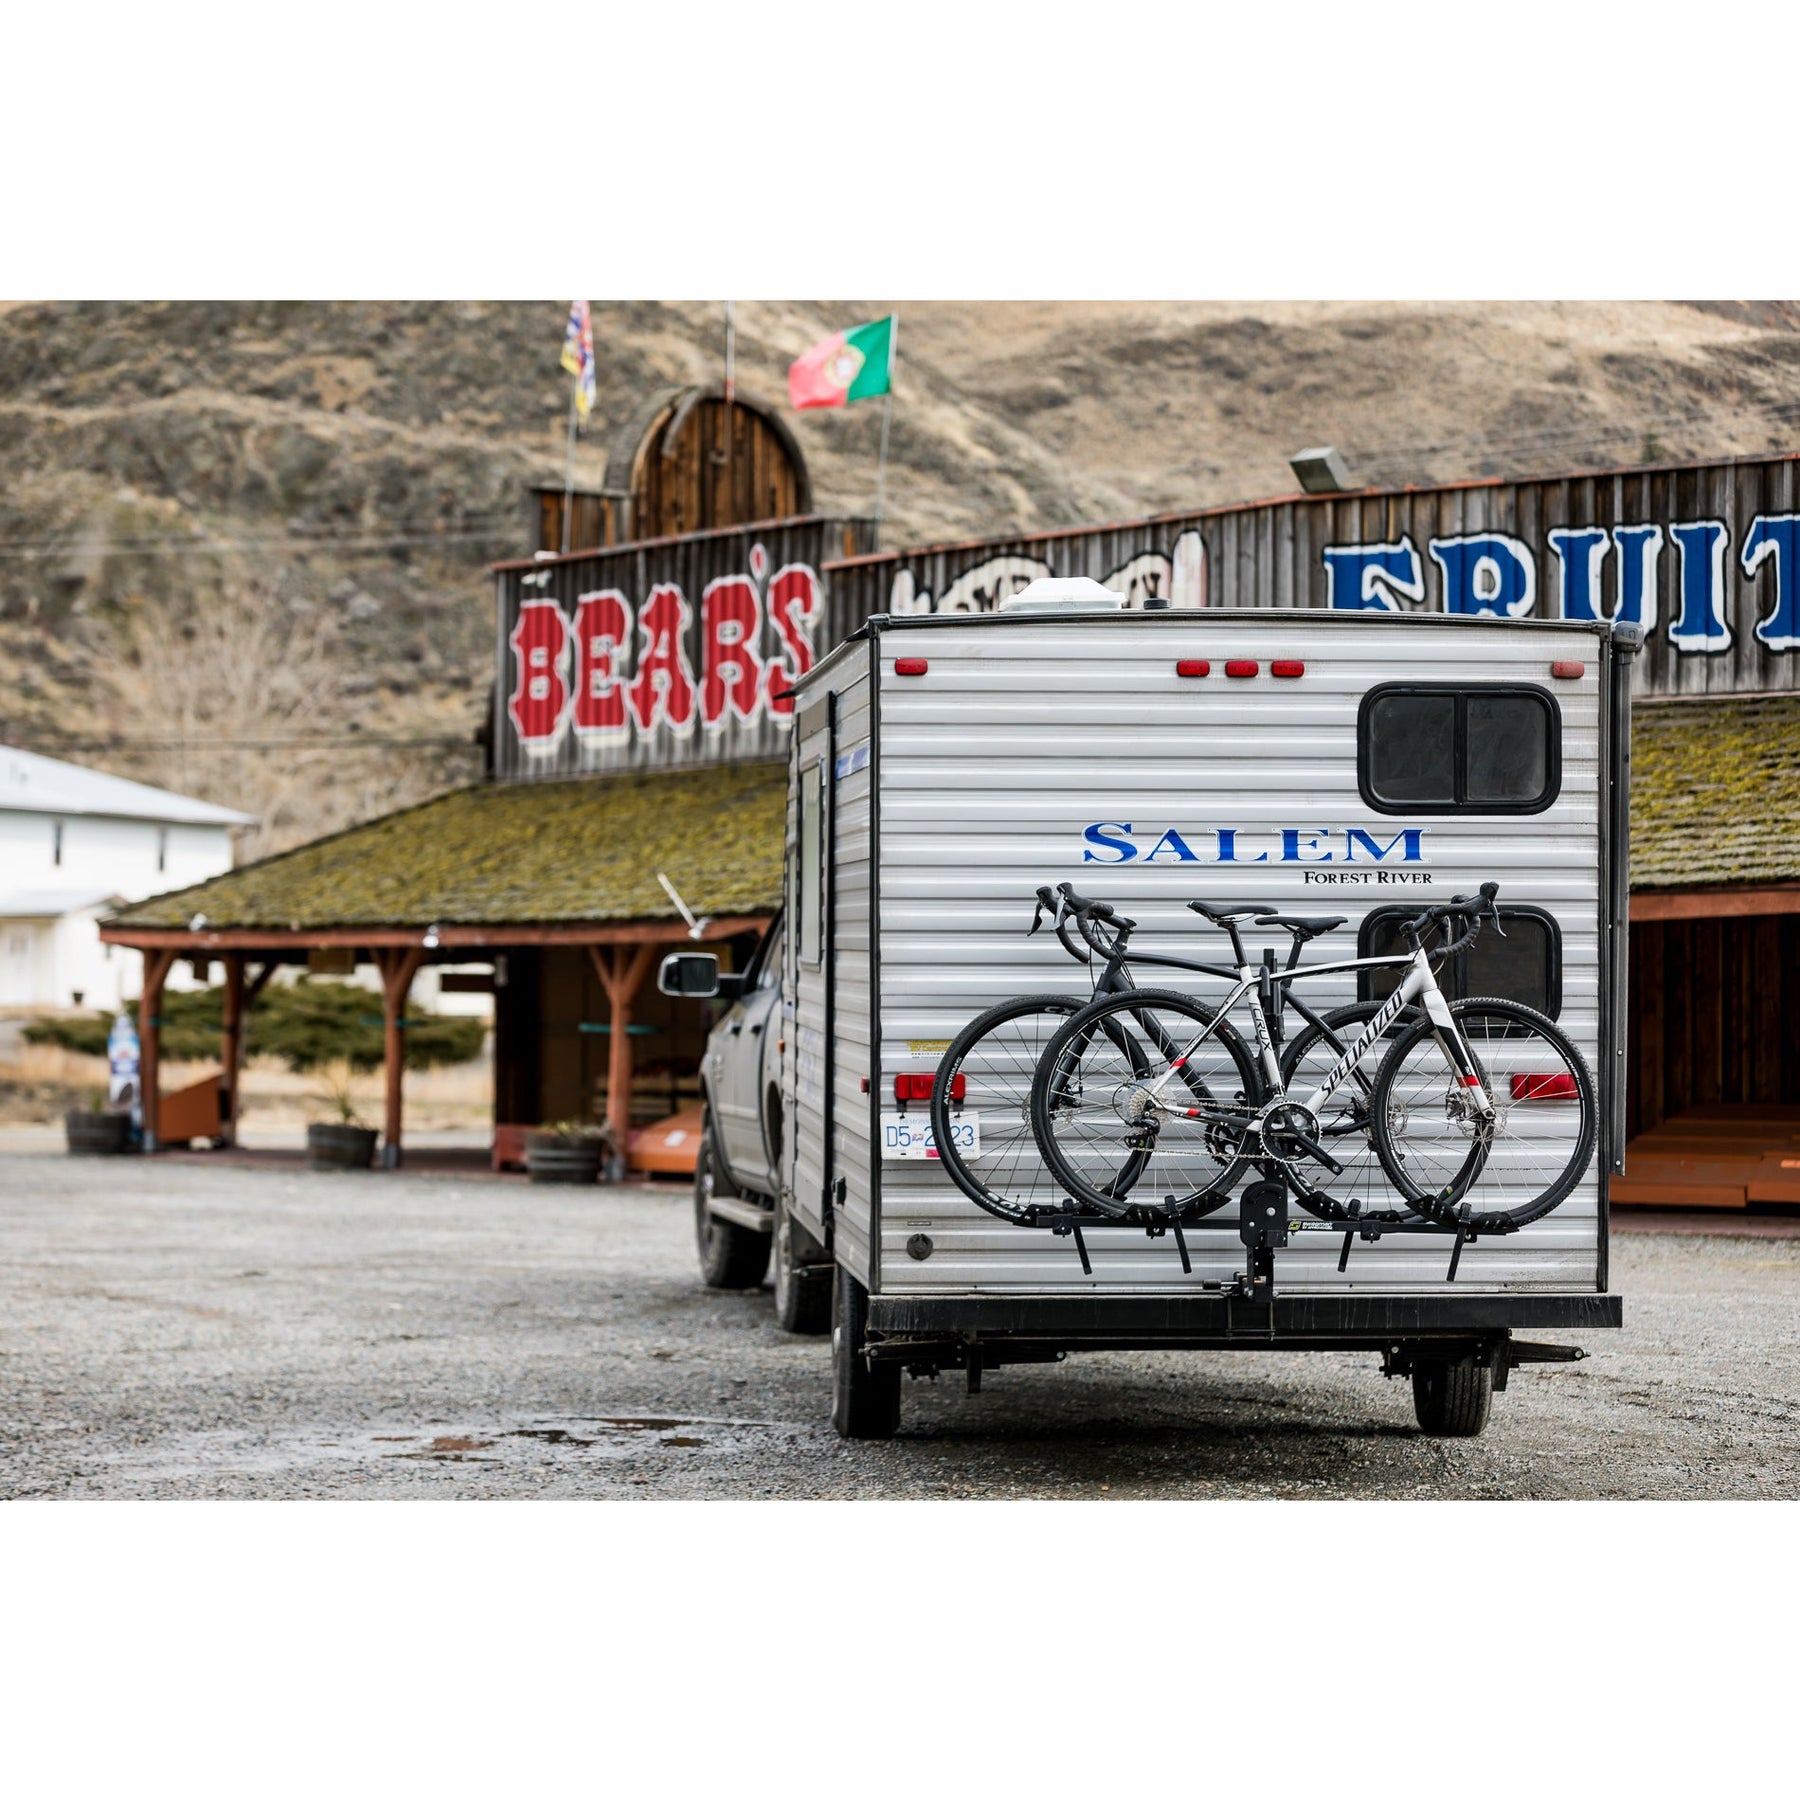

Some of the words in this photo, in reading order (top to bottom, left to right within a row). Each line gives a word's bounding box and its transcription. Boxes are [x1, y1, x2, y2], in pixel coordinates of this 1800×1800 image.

[510, 543, 822, 757] BEAR'S
[1081, 821, 1432, 864] SALEM
[1304, 870, 1372, 885] FOREST
[1376, 870, 1433, 885] RIVER
[1252, 1007, 1273, 1052] CRUX
[1320, 989, 1403, 1096] SPECIALIZED
[924, 1124, 974, 1147] 223
